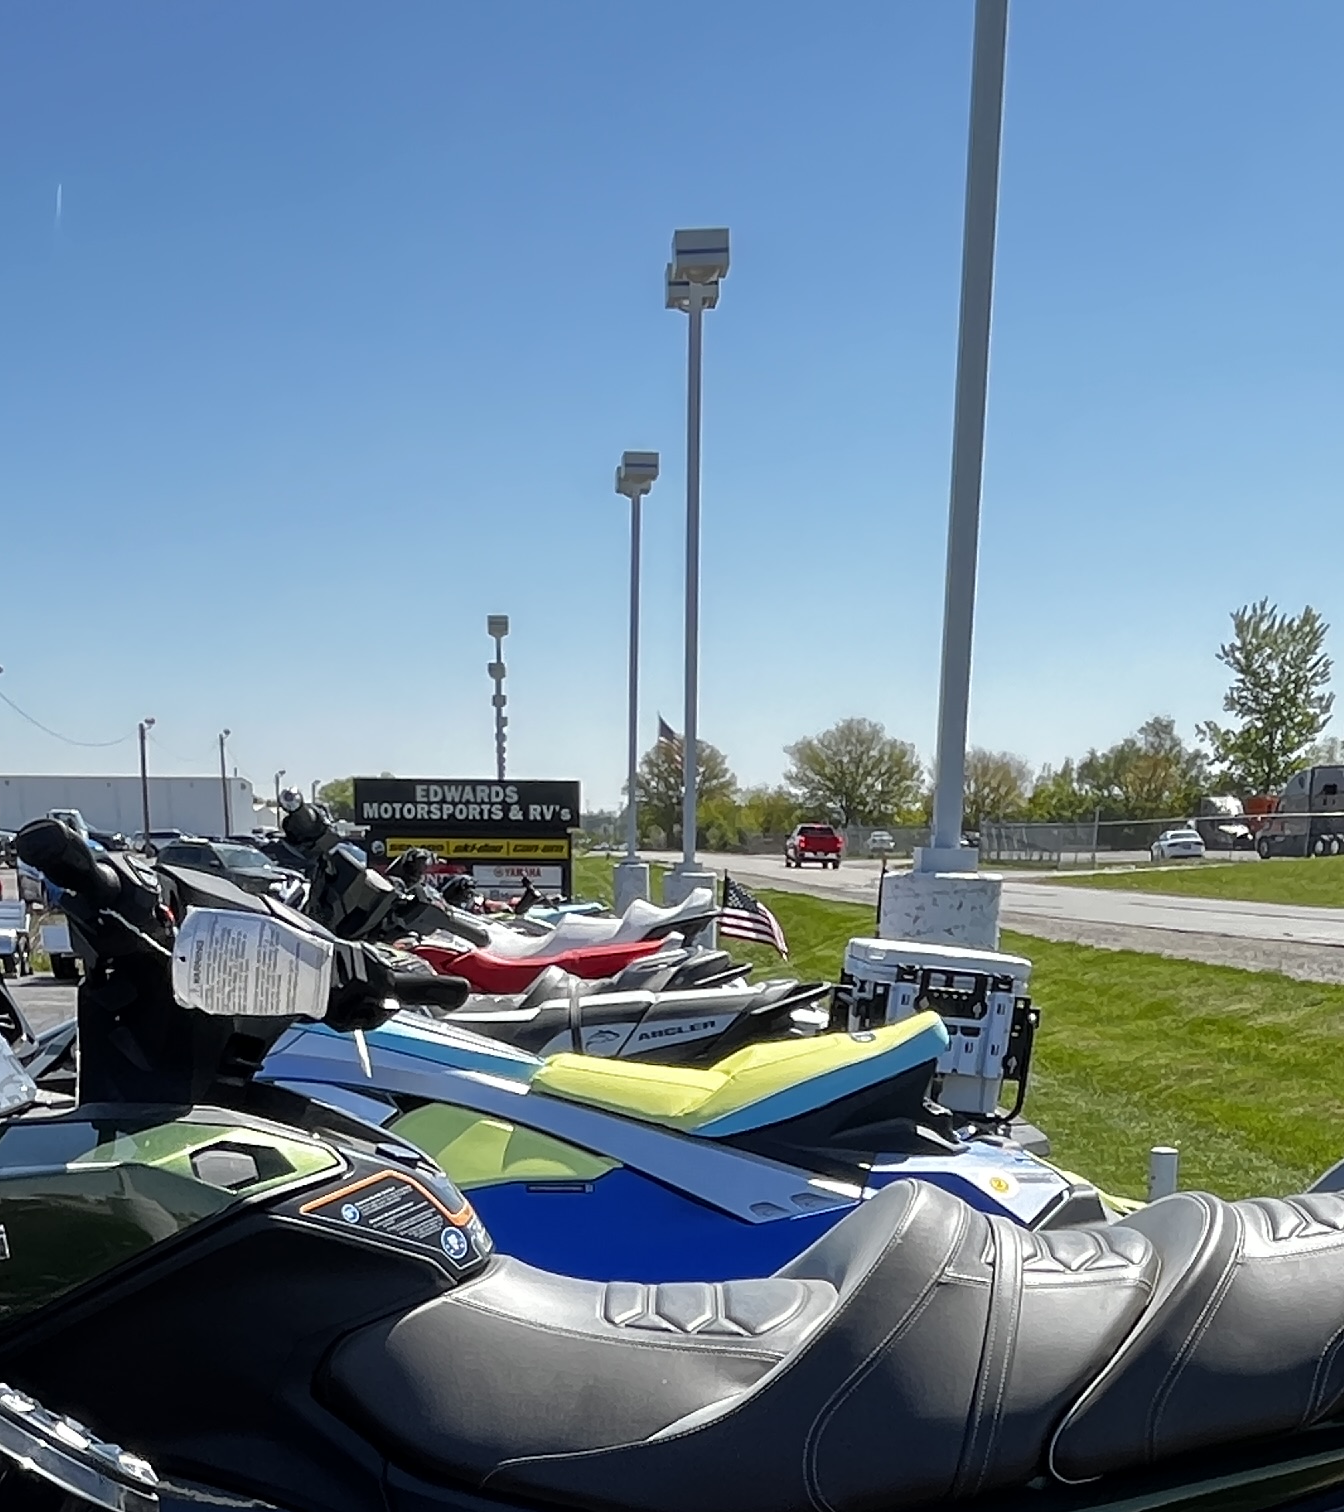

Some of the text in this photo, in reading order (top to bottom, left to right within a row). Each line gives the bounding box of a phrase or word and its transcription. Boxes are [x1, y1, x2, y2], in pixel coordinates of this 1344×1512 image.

[415, 785, 519, 803] EDWARDS
[363, 803, 572, 821] MOTORSPORTS & RV's
[505, 866, 541, 877] YAMAHA
